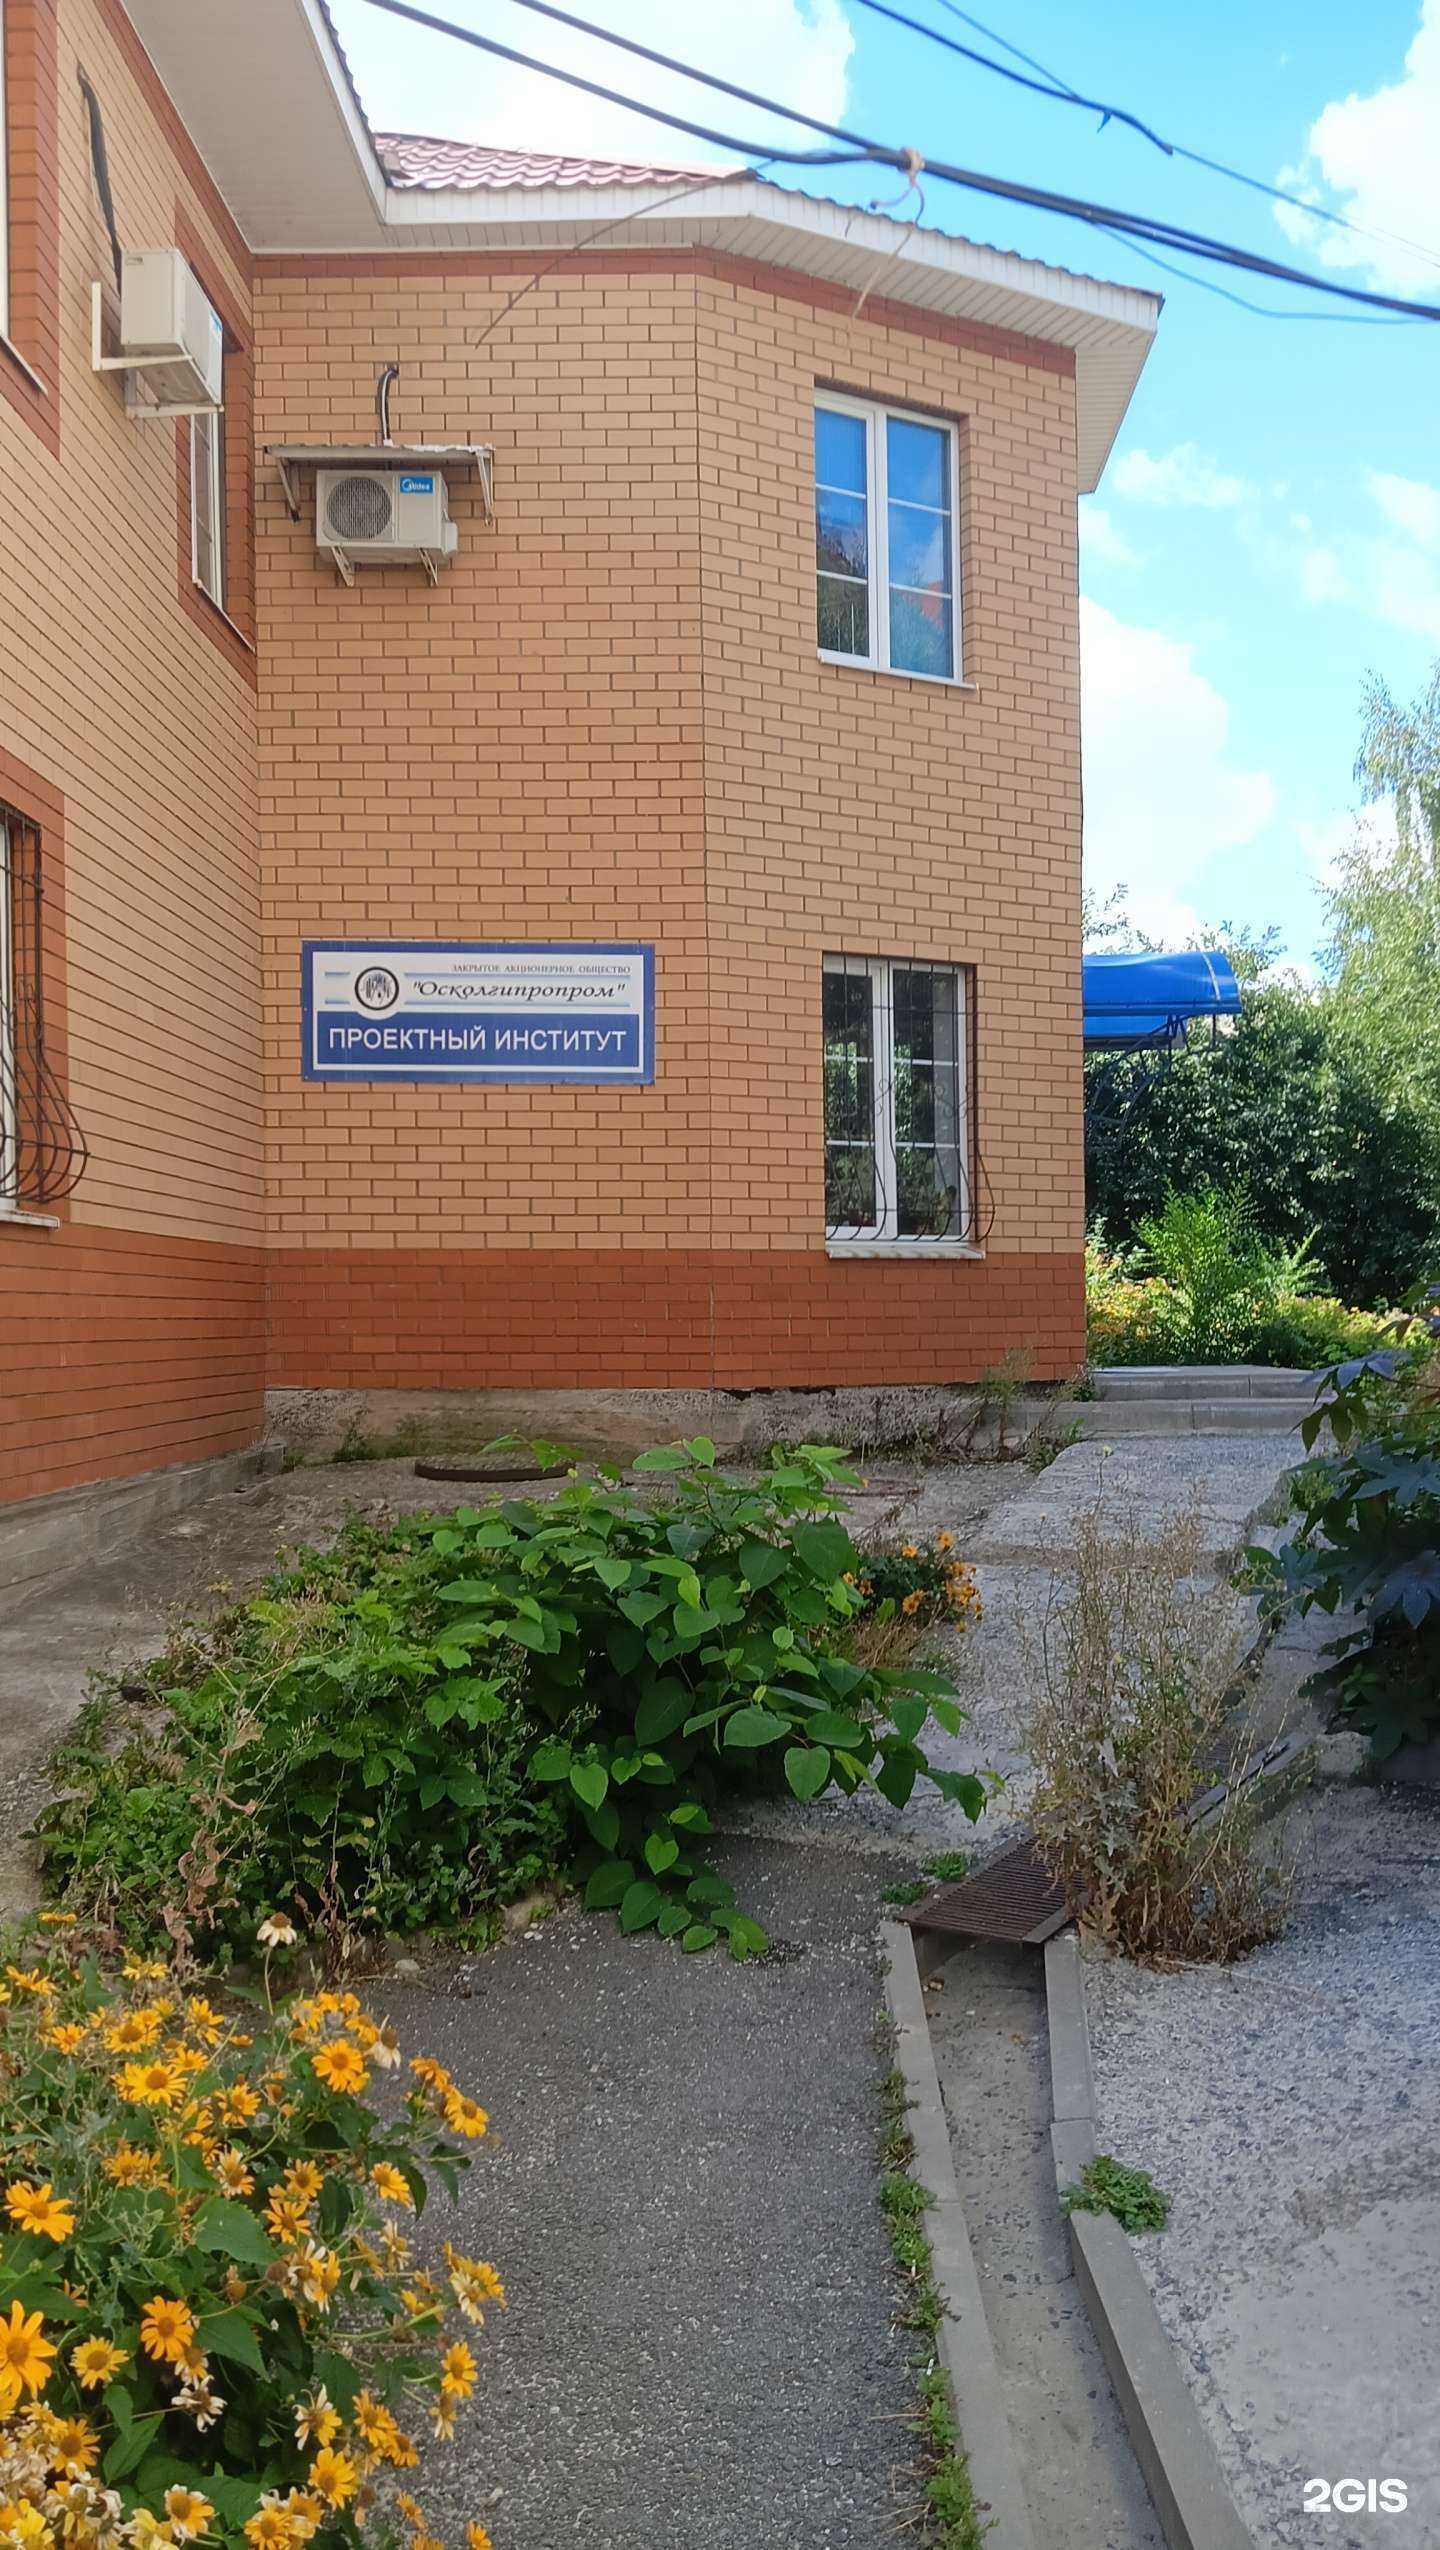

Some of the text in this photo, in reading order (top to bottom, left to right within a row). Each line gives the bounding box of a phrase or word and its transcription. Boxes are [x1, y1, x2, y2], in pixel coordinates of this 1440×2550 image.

[453, 964, 631, 975] ЗАКРЫТОЕ АКЦИОНЕРНОЕ ОБЩЕСТВО
[413, 980, 626, 1001] "Осколгипропром"
[329, 1025, 626, 1051] ПРОЕКТНЫЙ ИНСТИТУТ
